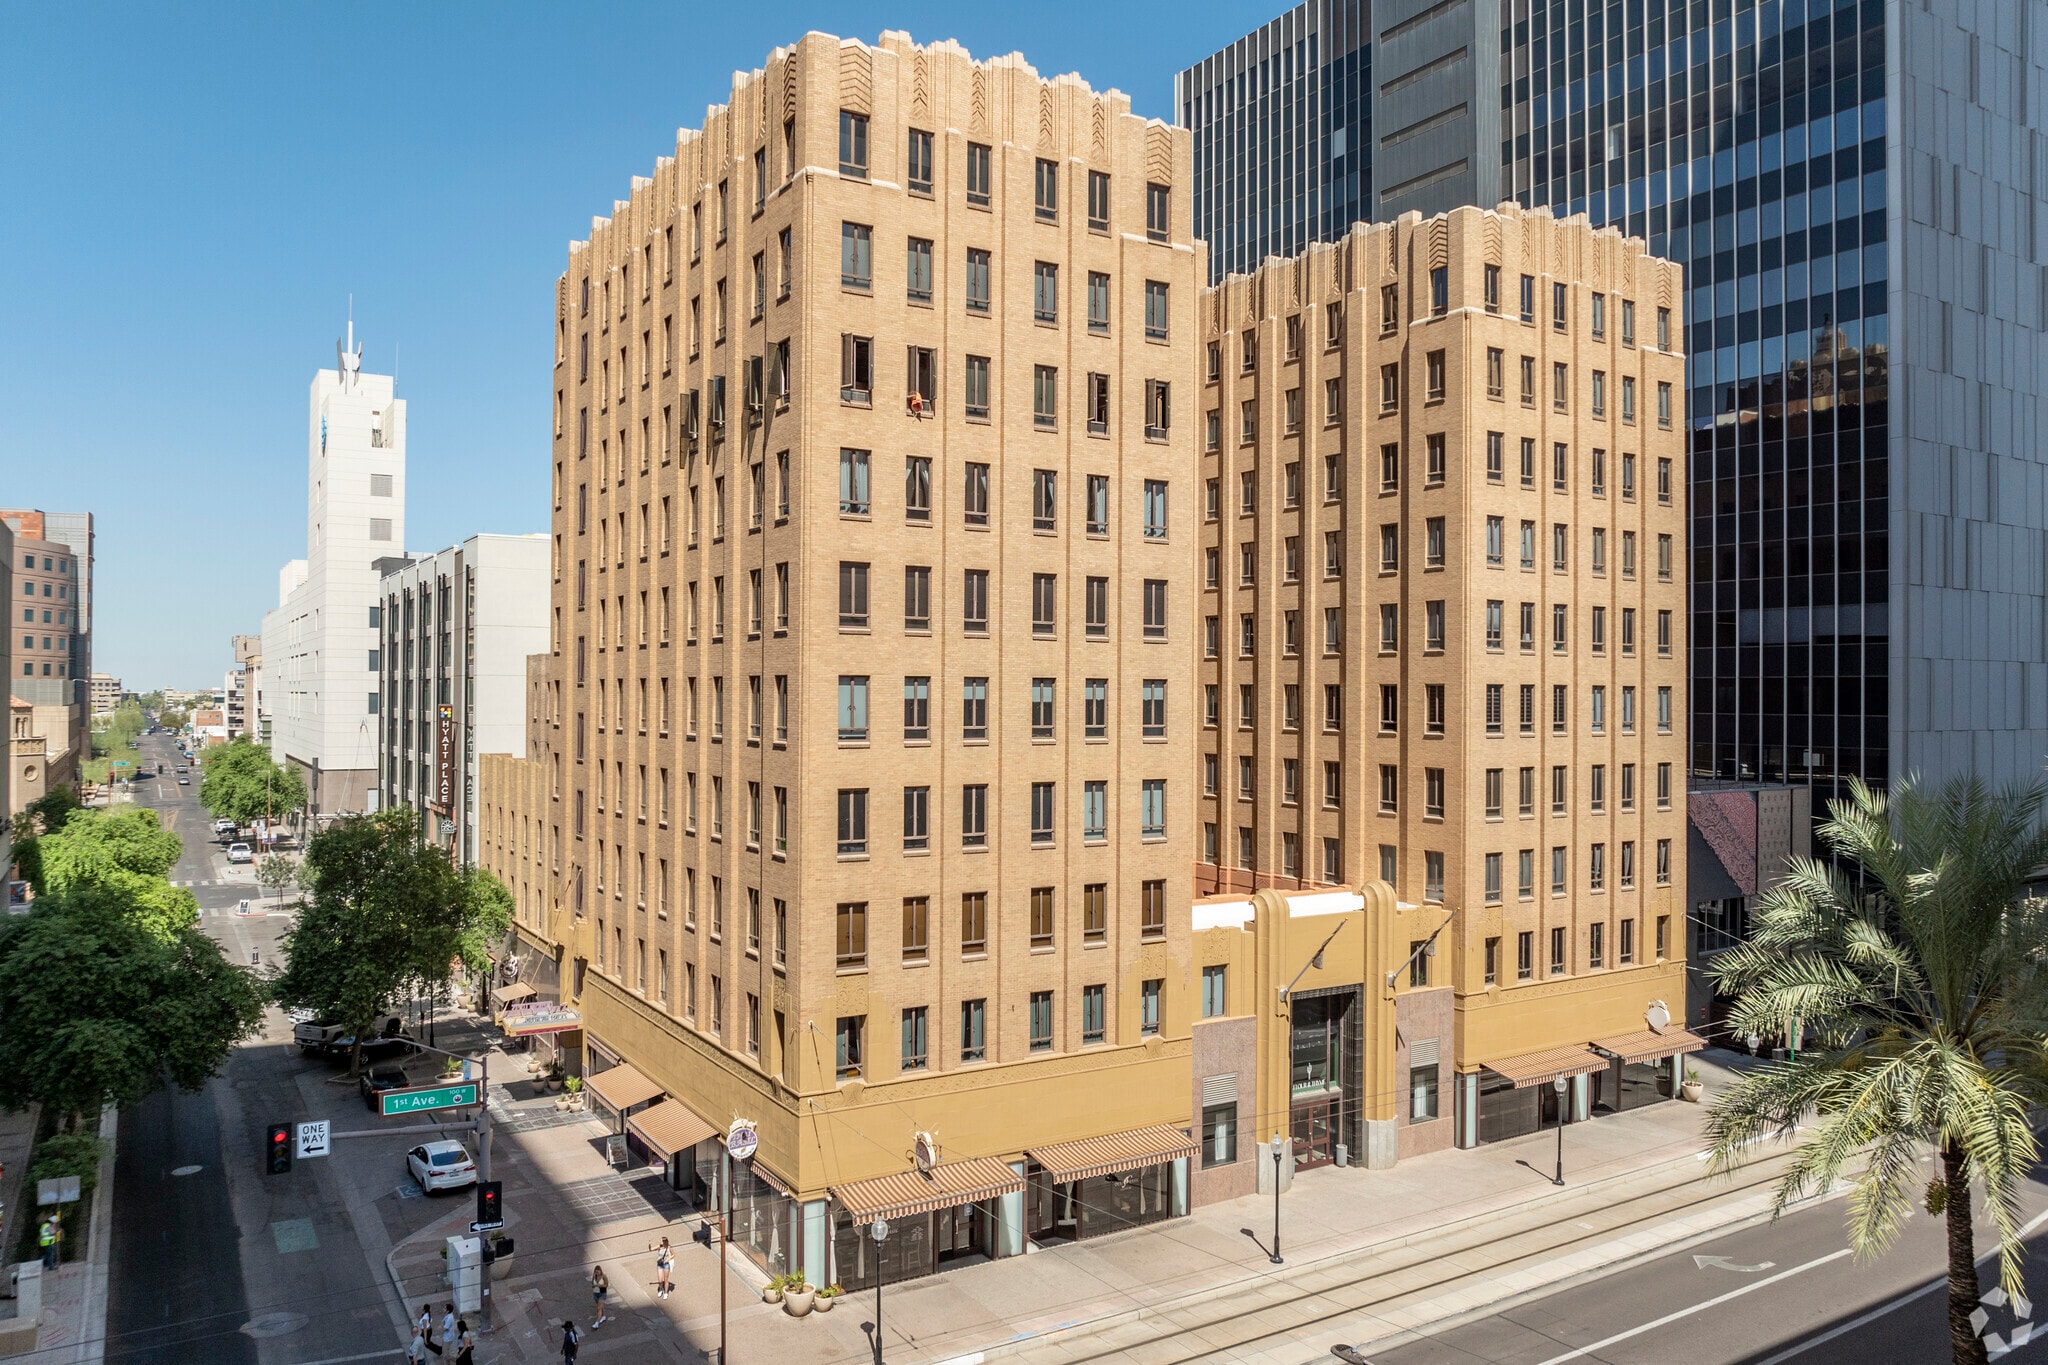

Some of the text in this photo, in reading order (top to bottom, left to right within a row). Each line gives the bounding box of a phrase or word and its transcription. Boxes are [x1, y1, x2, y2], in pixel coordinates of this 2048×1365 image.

[394, 1096, 439, 1108] 1st Ave.
[302, 1124, 324, 1134] ONE
[302, 1134, 324, 1144] WAY
